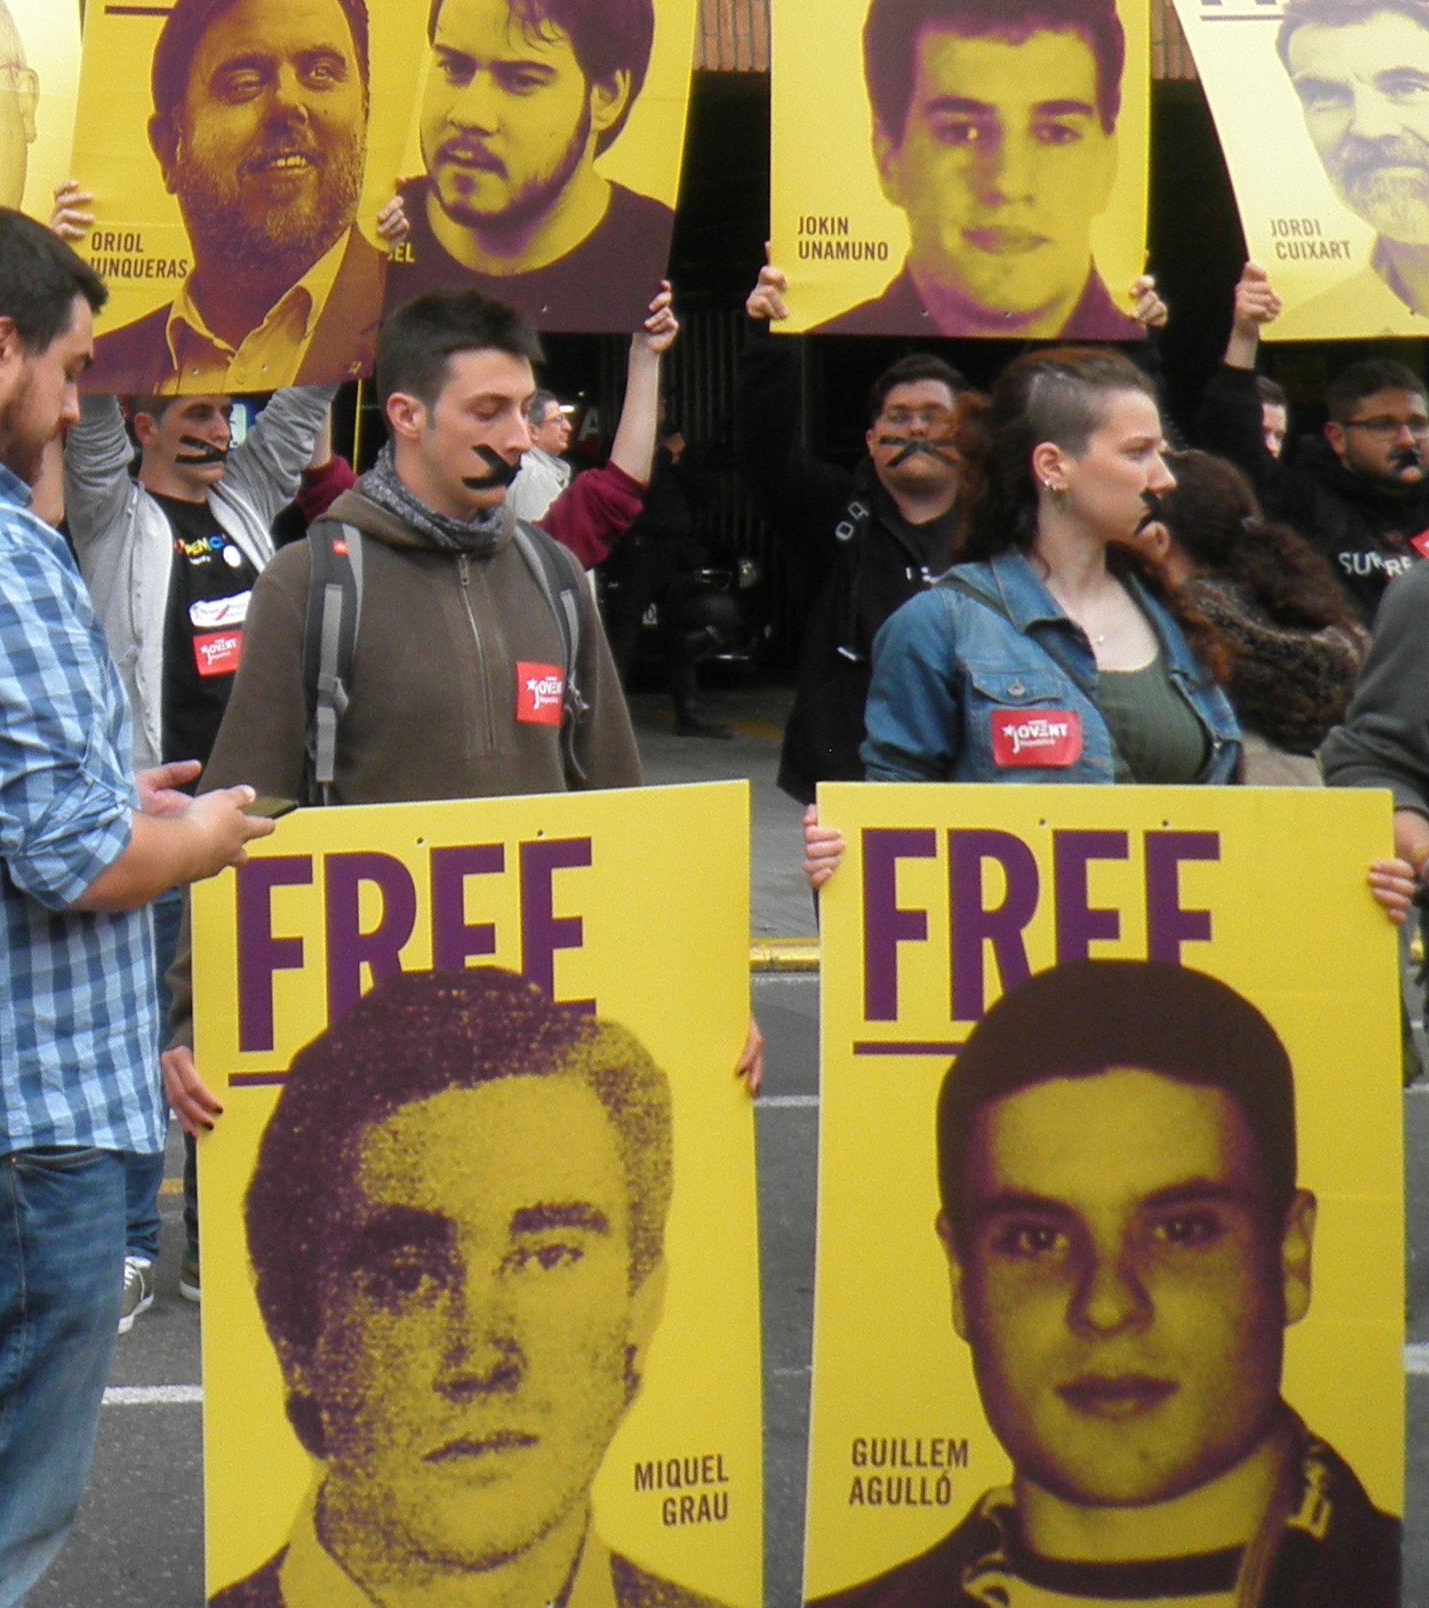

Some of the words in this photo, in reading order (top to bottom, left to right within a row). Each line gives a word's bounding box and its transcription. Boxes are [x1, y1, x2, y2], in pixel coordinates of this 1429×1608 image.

[91, 232, 144, 252] ORIOL
[797, 216, 849, 236] JOKIN
[1270, 218, 1321, 238] JORDI
[798, 241, 889, 261] UNAMUNO
[1276, 240, 1352, 260] CUIXART
[861, 827, 1220, 1023] FREE
[236, 836, 597, 1053] FREE
[851, 1438, 969, 1470] GUILLEM
[633, 1454, 729, 1493] MIQUEL
[849, 1470, 952, 1507] AGULLÓ
[662, 1494, 729, 1527] GRAU
